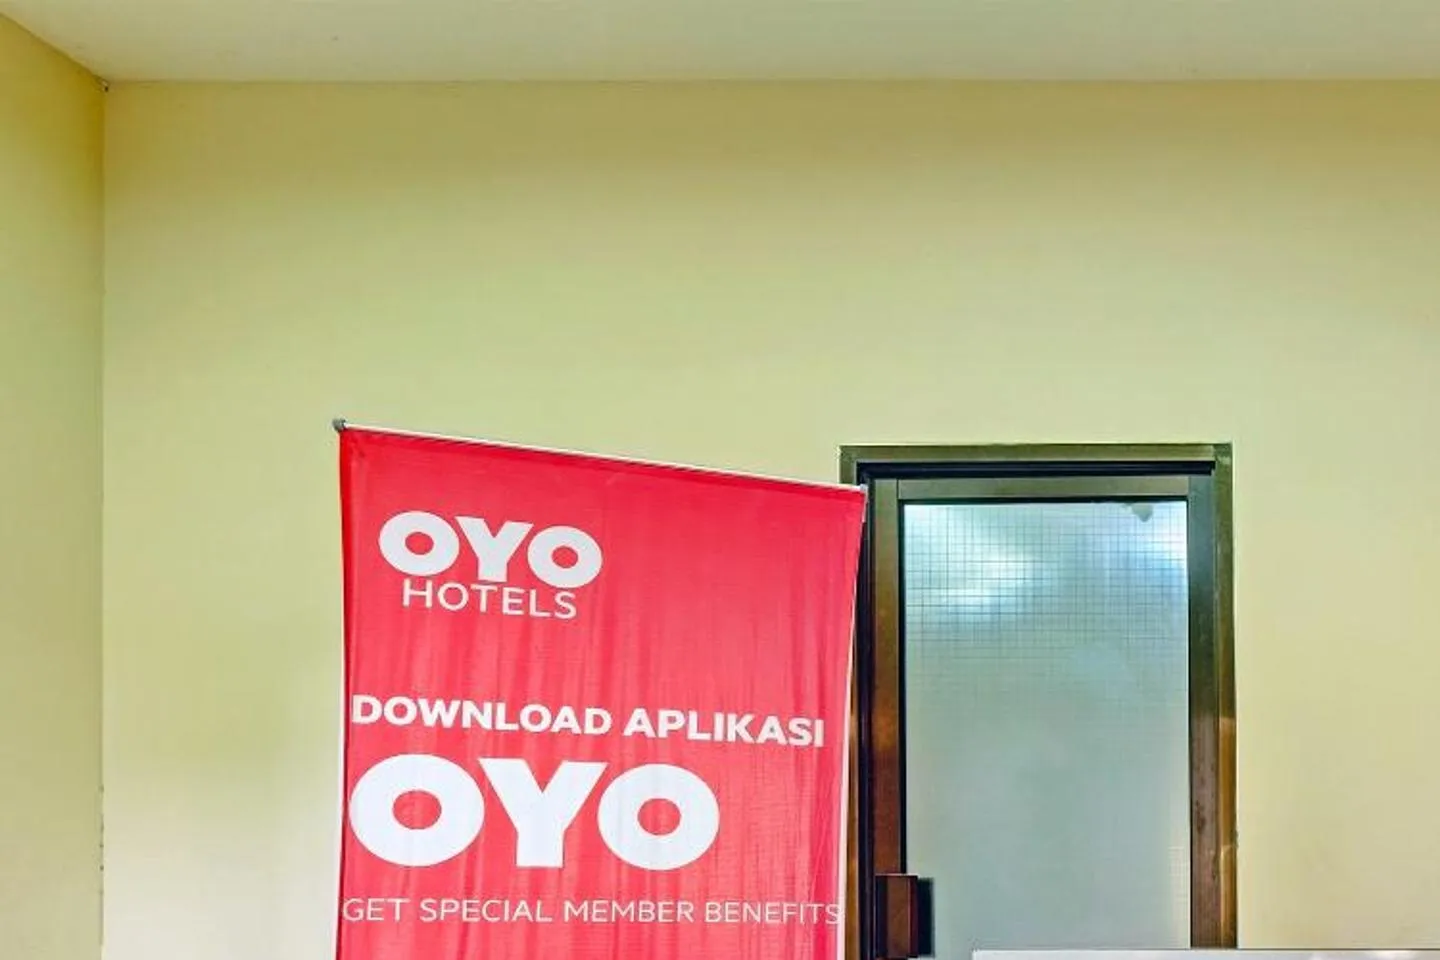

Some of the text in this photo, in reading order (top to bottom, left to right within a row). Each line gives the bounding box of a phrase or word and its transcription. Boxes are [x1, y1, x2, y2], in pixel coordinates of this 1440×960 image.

[379, 510, 603, 588] OYO
[402, 579, 577, 619] HOTELS
[352, 694, 825, 747] DOWNLOAD APLIKASI
[349, 753, 720, 871] OYO
[343, 898, 842, 925] GET SPECIAL MEMBER BENEFITS
